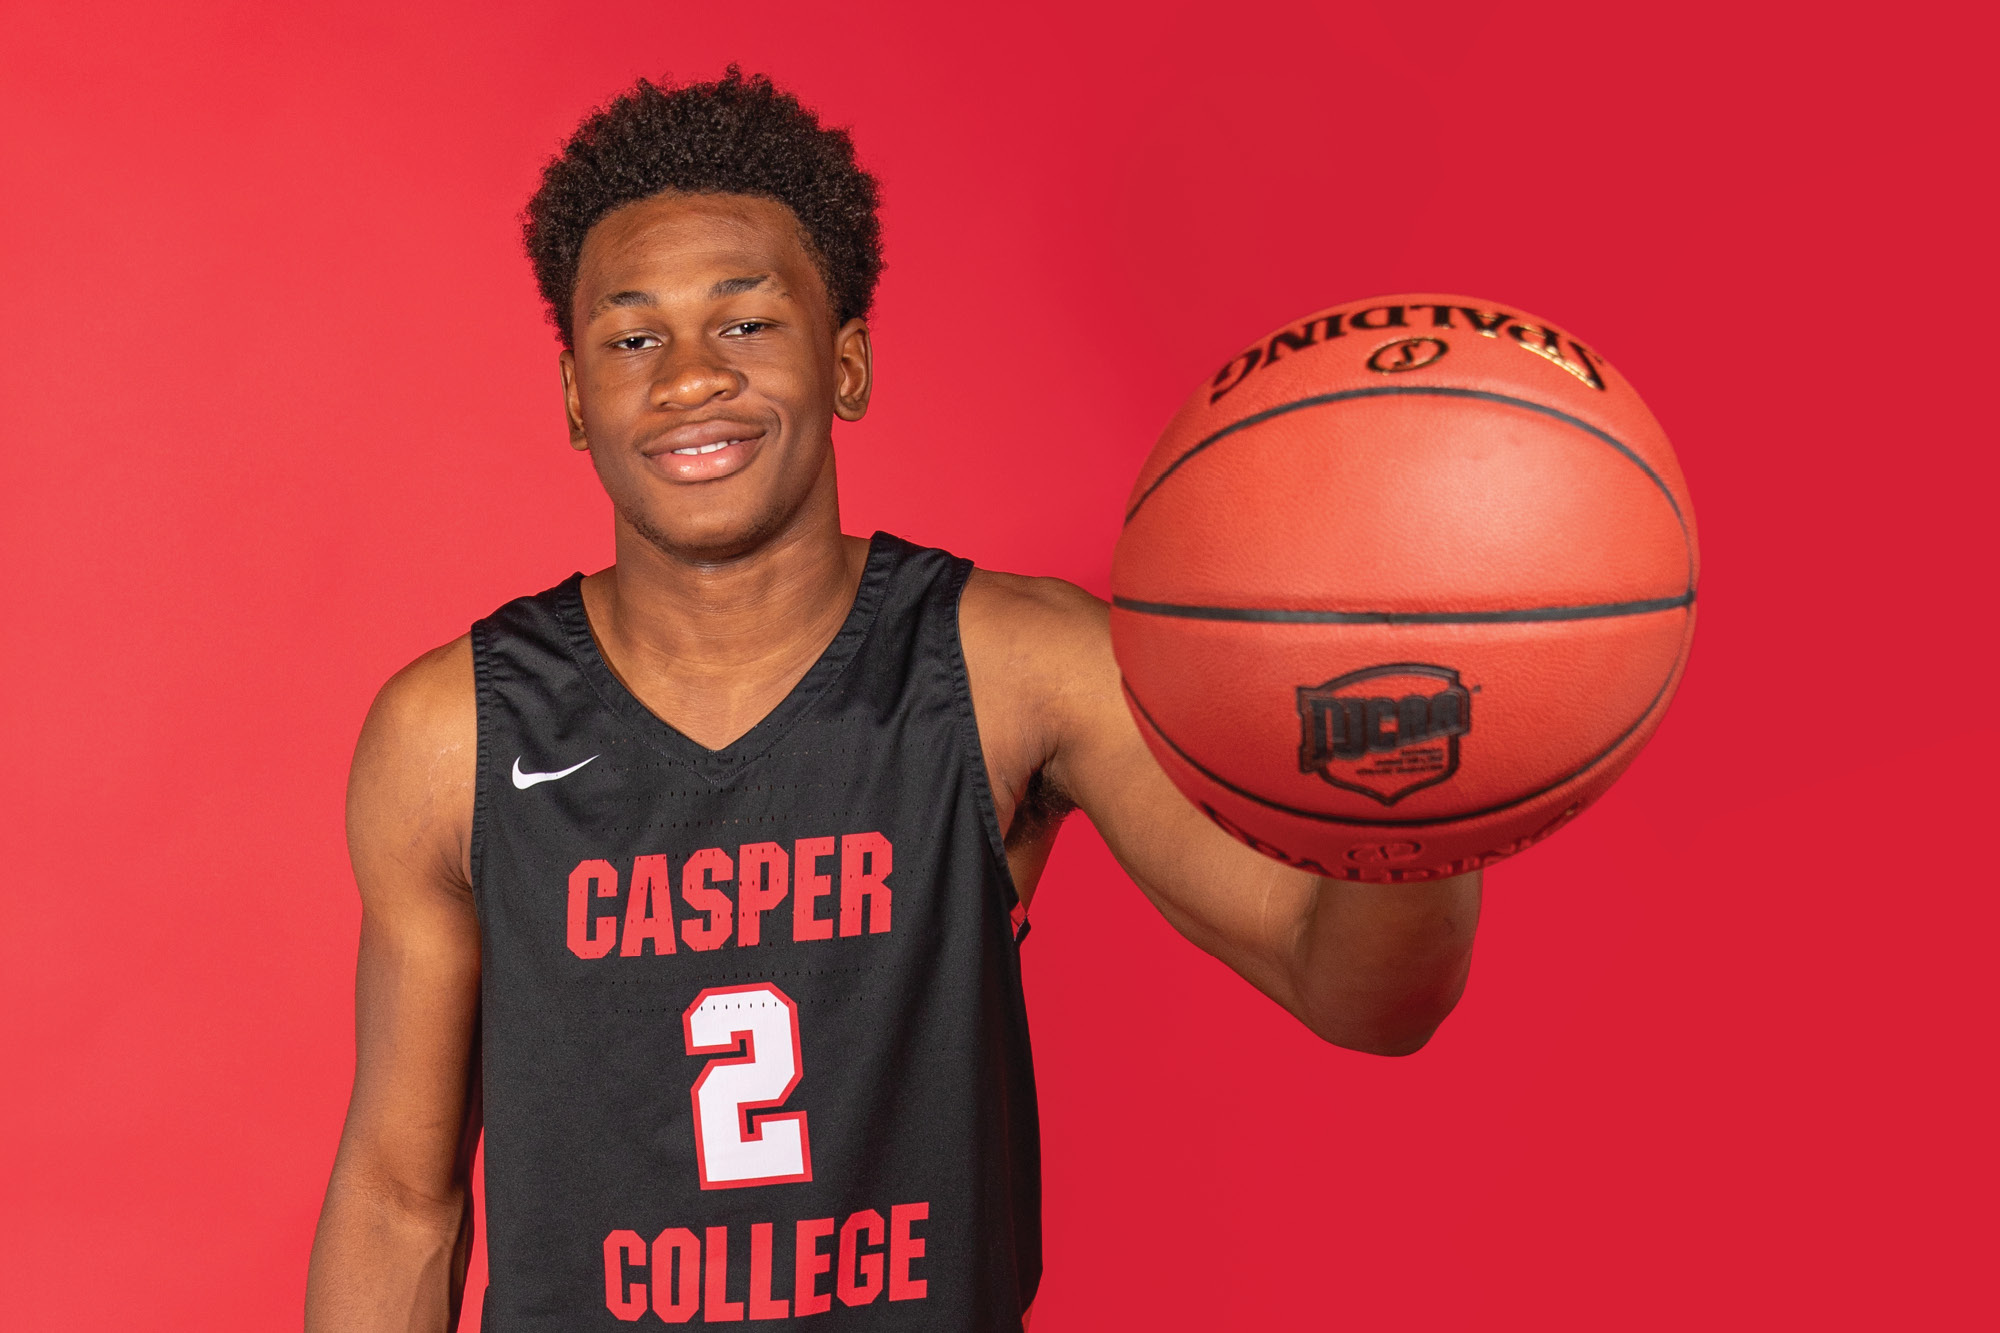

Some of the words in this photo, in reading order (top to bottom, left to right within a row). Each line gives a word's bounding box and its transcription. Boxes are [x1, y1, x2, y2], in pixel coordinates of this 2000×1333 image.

[1209, 304, 1607, 406] SPALDING
[567, 831, 893, 960] CASPER
[682, 981, 813, 1191] 2
[603, 1202, 929, 1324] COLLEGE
